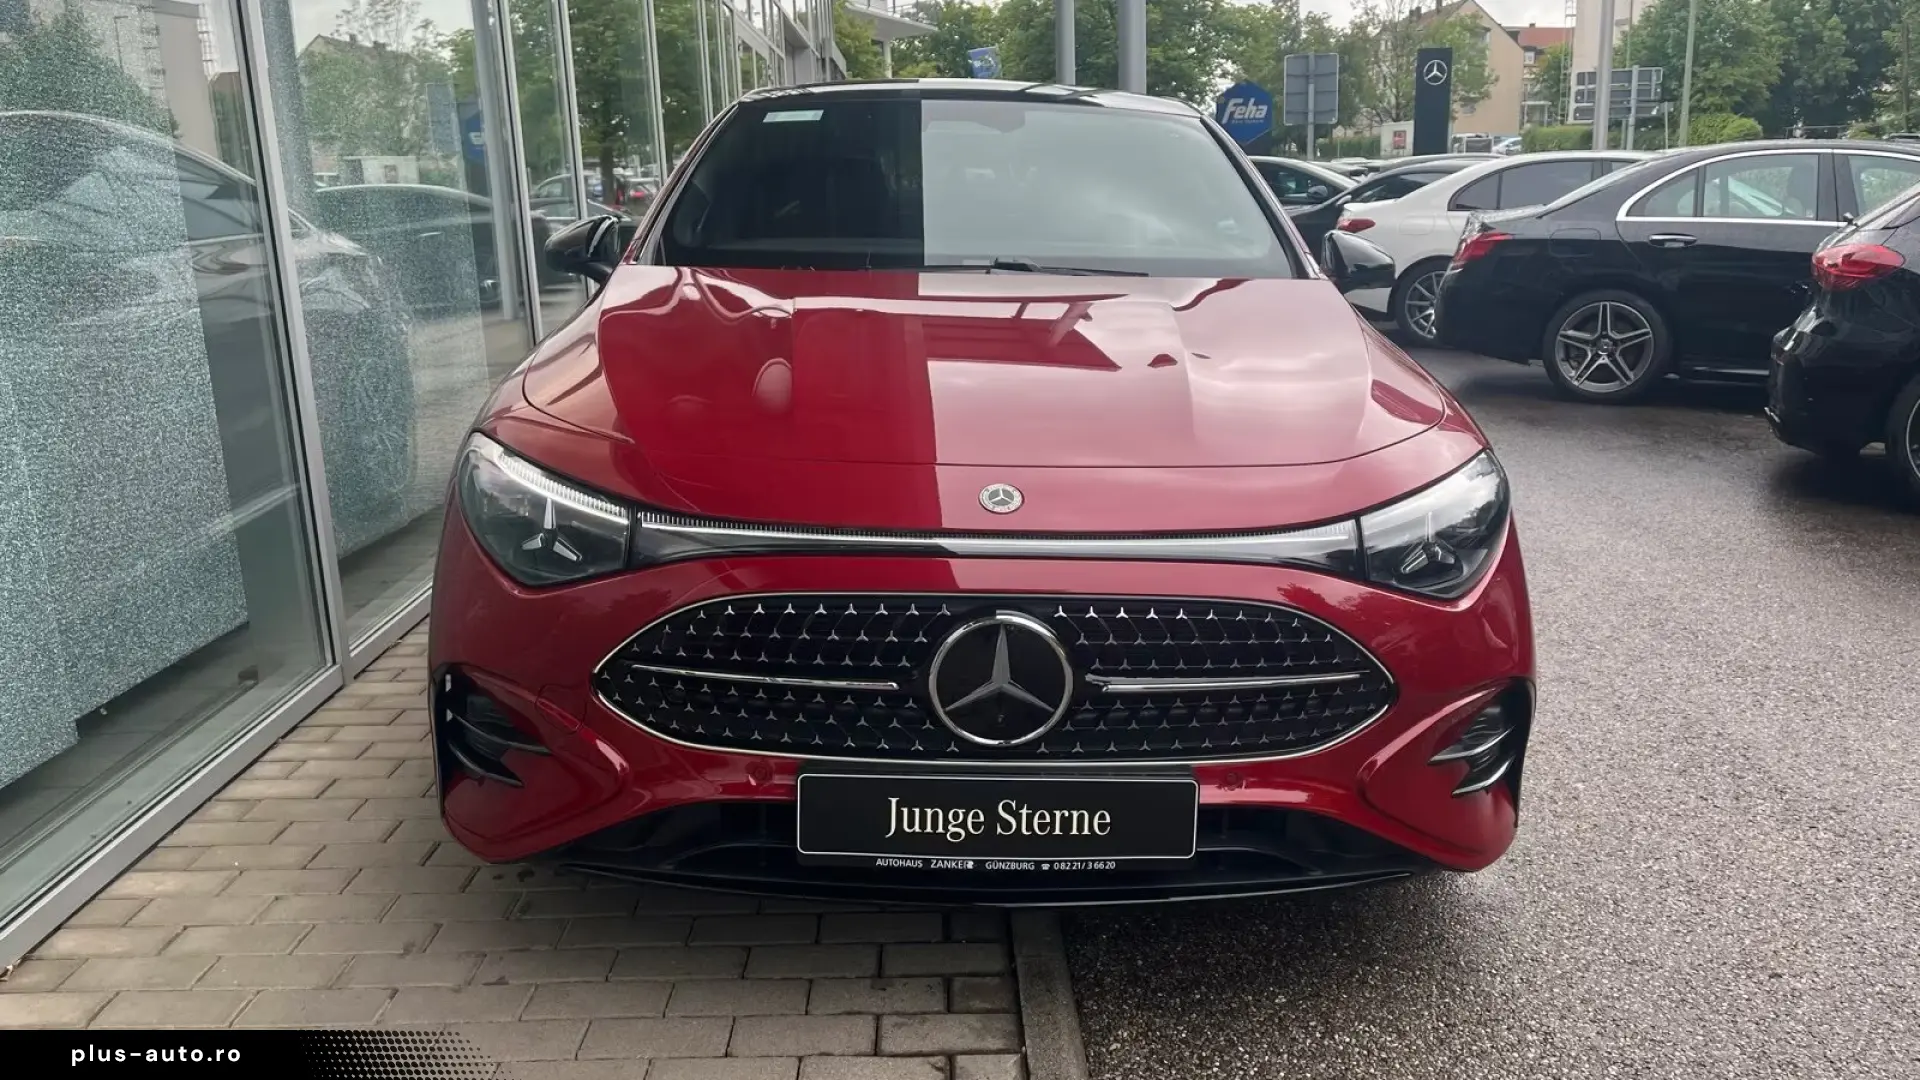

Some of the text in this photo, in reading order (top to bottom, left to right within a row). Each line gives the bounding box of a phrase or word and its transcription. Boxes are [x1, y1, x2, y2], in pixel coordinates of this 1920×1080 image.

[1221, 97, 1268, 124] Feha
[886, 797, 1111, 842] Junge Sterne
[876, 858, 923, 868] AUTOHAUS
[985, 860, 1035, 870] GÜNZBURG
